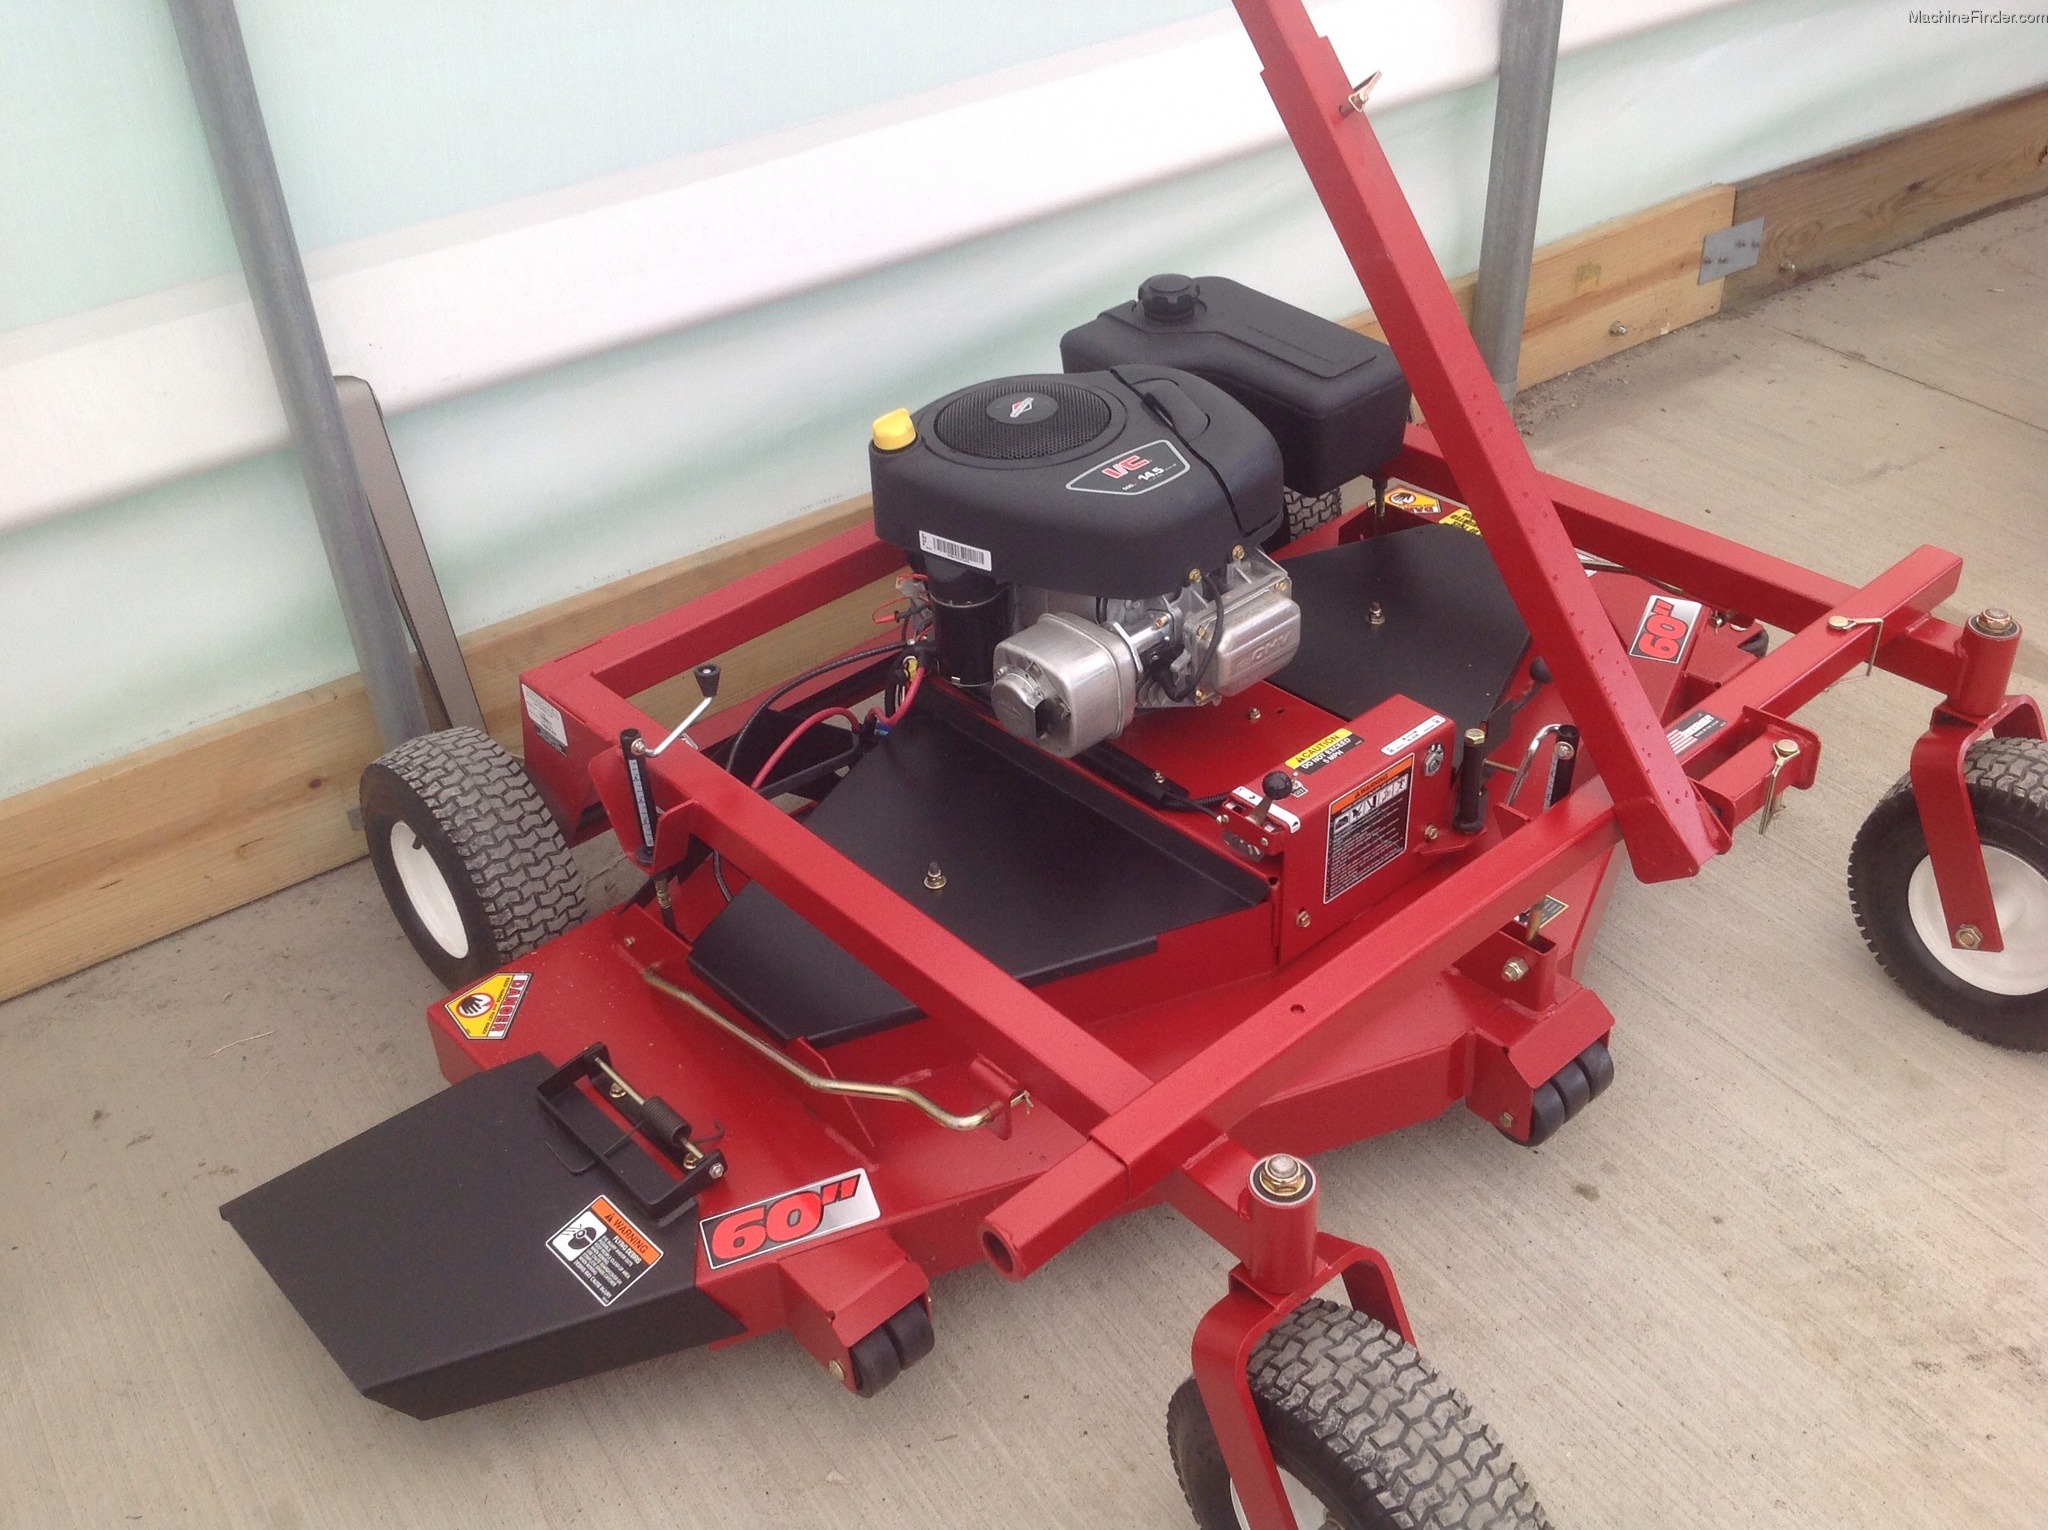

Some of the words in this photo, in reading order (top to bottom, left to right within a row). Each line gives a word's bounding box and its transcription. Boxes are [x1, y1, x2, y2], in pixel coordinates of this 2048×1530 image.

[1137, 466, 1165, 481] 14.5
[1638, 597, 1689, 660] 60"
[1301, 761, 1314, 769] DO
[1312, 753, 1326, 763] NOT
[1325, 737, 1351, 755] EXCEED
[1302, 734, 1340, 758] CAUTION
[1327, 750, 1344, 761] MPH
[491, 980, 525, 1031] DANGER
[711, 1174, 860, 1260] 60"
[612, 1235, 629, 1251] FLYING
[625, 1247, 642, 1265] DEBRIS
[613, 1218, 649, 1254] WARNING
